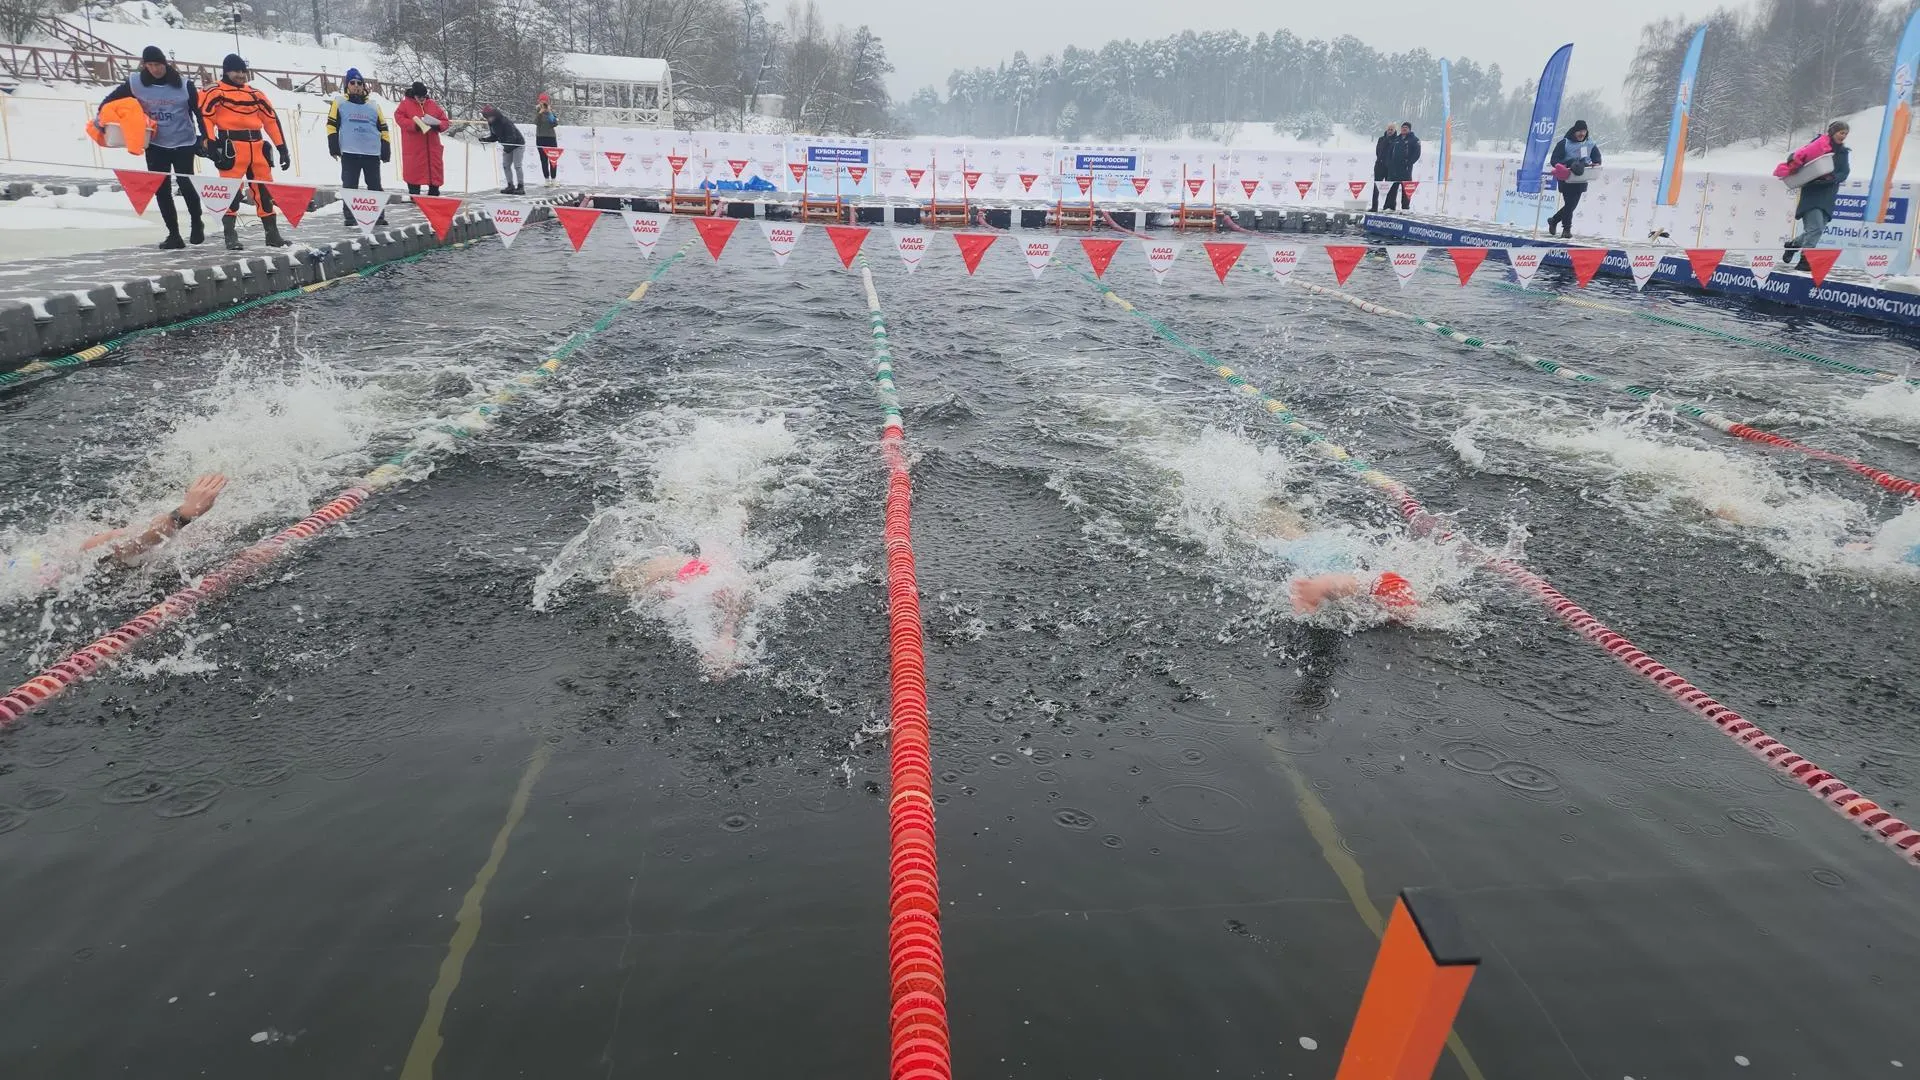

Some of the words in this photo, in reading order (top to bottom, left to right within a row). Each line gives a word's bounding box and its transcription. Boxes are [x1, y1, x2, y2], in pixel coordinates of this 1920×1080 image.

[203, 184, 228, 192] MAD
[201, 192, 231, 200] WAVE
[351, 204, 380, 212] WAVE
[495, 216, 522, 224] WAVE
[1872, 230, 1903, 241] ЭТАП
